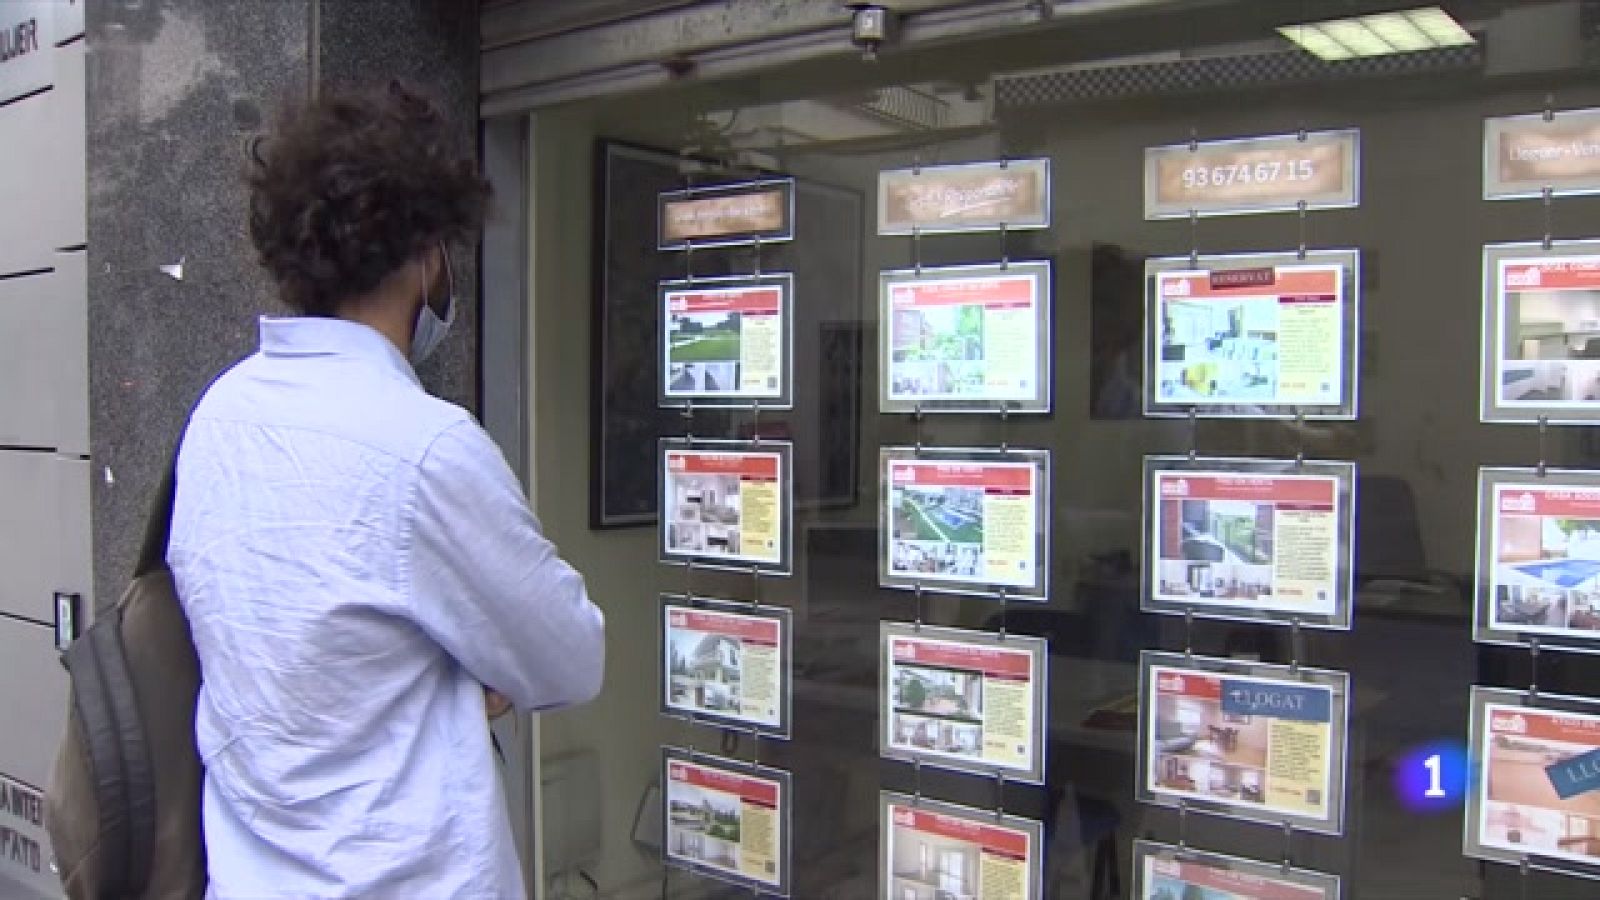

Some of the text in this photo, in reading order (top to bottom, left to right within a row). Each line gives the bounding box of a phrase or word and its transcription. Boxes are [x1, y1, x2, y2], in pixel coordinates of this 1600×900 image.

[1182, 159, 1313, 188] 93 674 67 15
